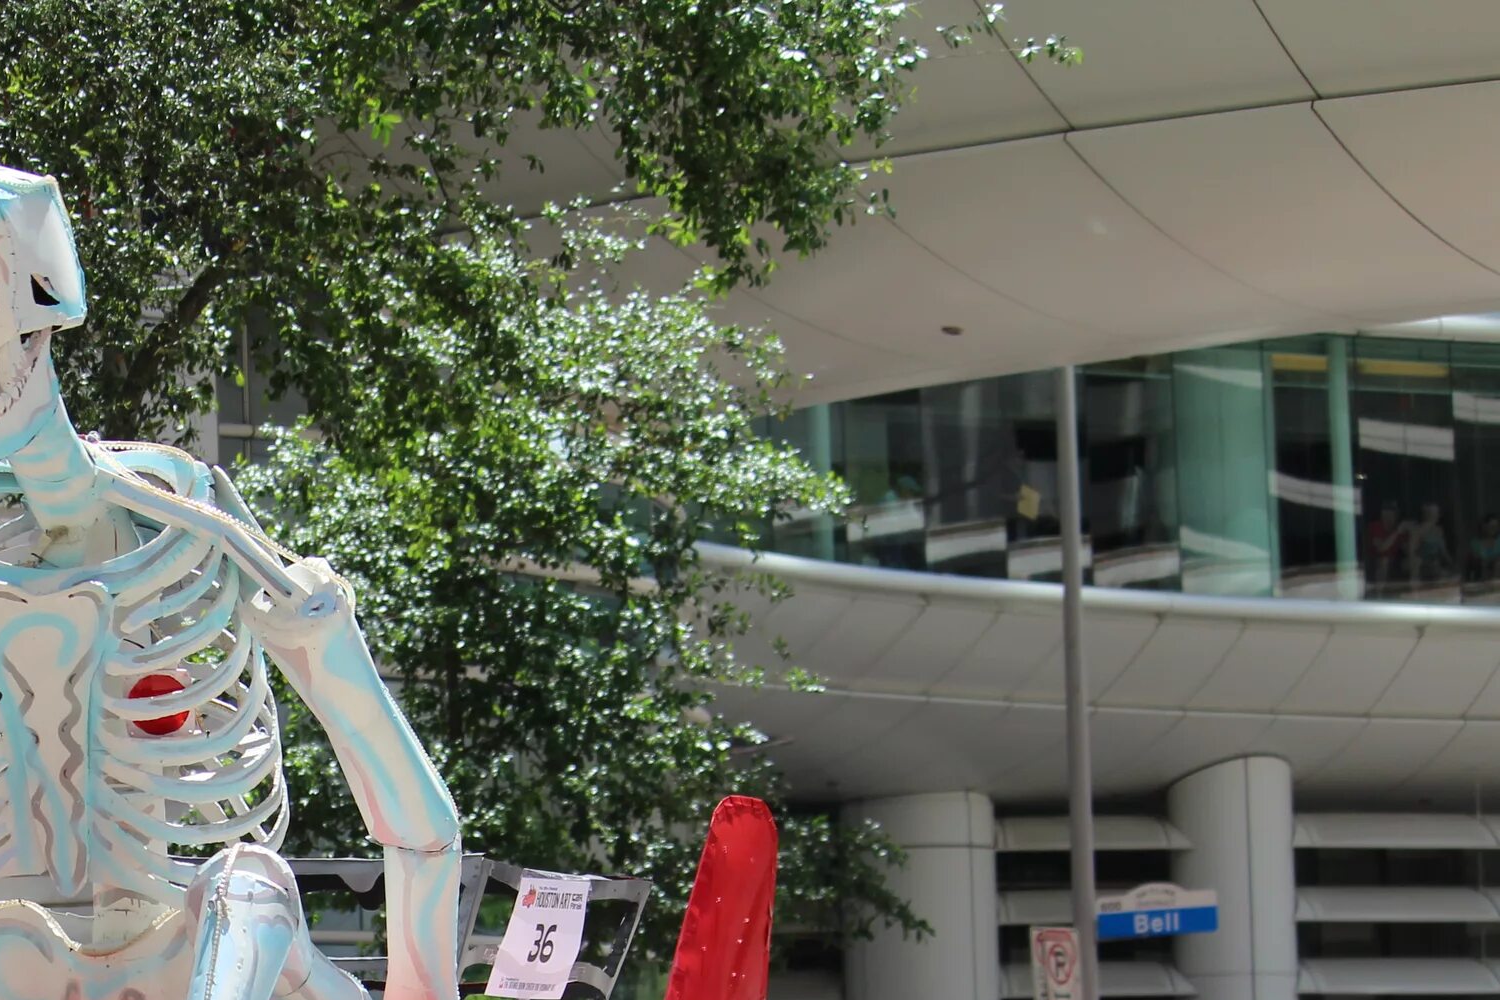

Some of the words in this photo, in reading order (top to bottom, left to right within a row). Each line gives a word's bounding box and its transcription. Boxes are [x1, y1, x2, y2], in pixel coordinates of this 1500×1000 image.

[535, 891, 560, 909] HOUSTON
[560, 892, 571, 909] ART
[1133, 911, 1179, 934] Bell
[527, 923, 558, 963] 36
